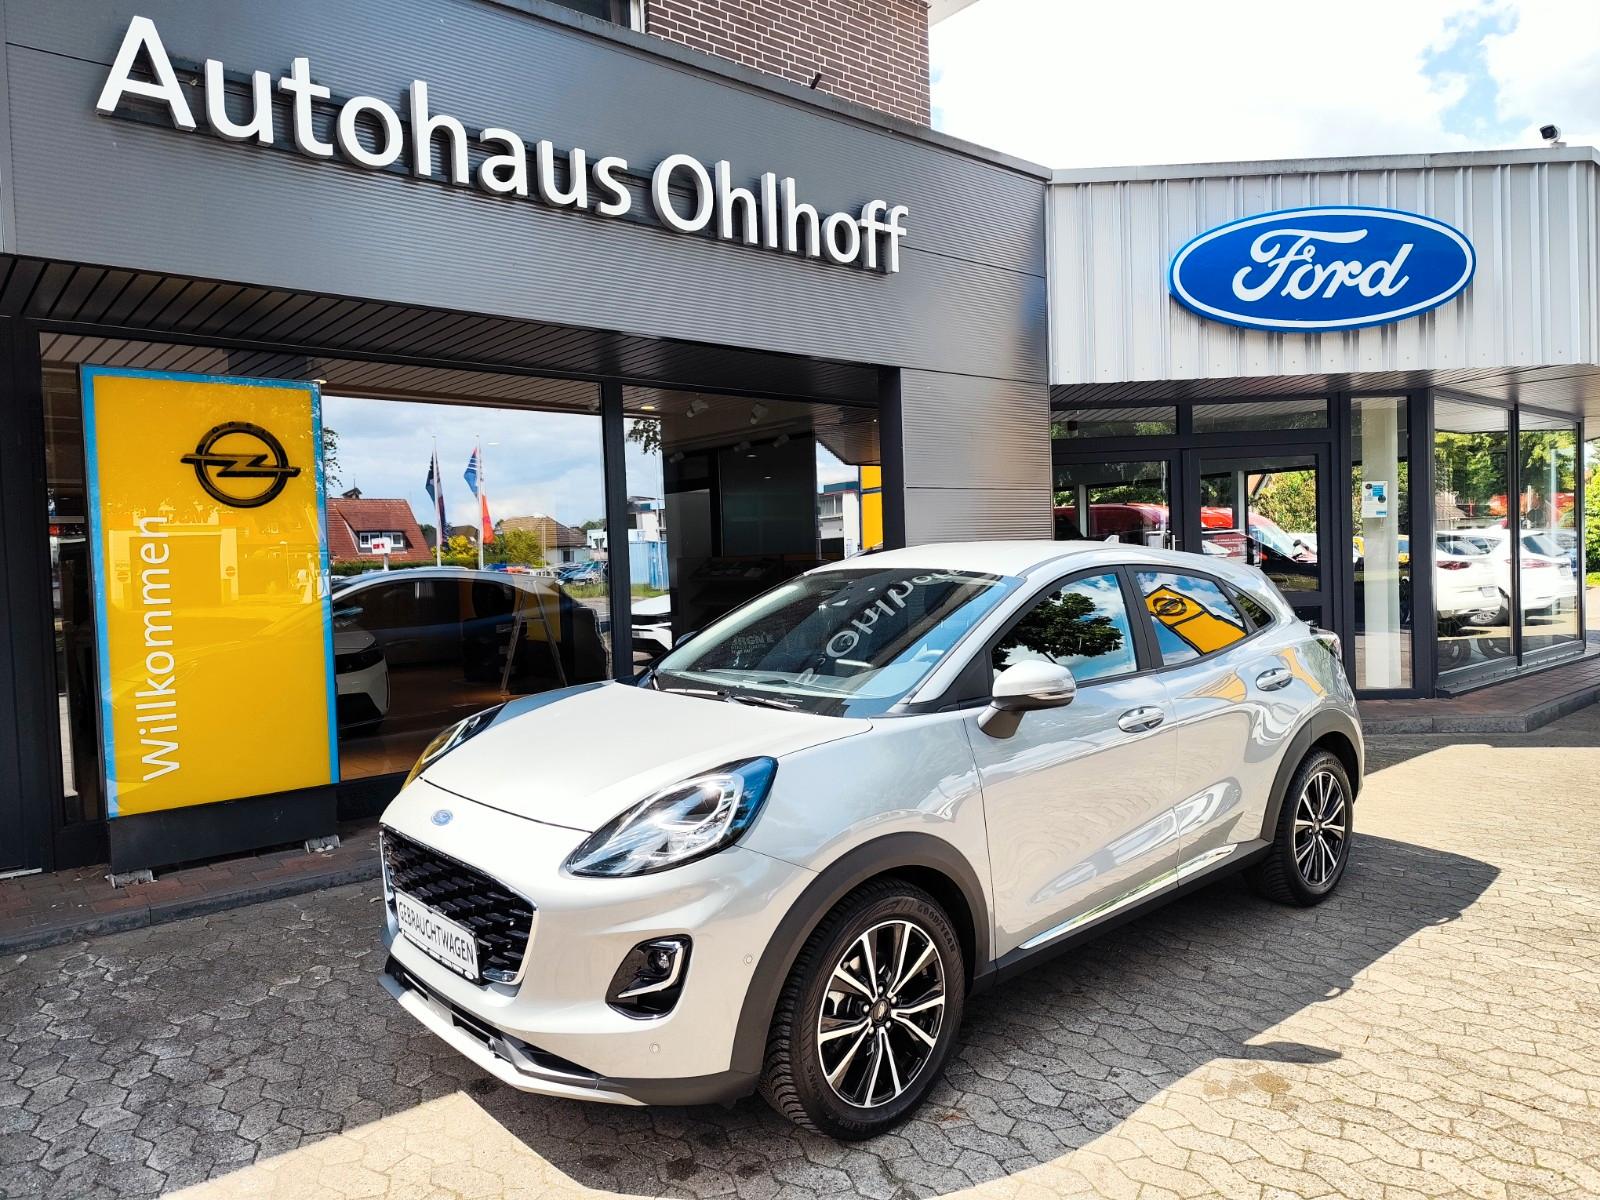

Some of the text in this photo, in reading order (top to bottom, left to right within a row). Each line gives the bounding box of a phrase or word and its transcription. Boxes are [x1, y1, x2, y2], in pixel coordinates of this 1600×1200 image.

[97, 16, 909, 274] Autohaus Ohlhoff
[1232, 228, 1413, 302] Ford
[135, 515, 181, 782] Willkommen
[398, 901, 475, 965] GEBRAUCHTWAGEN
[917, 904, 956, 953] GOODYEAR
